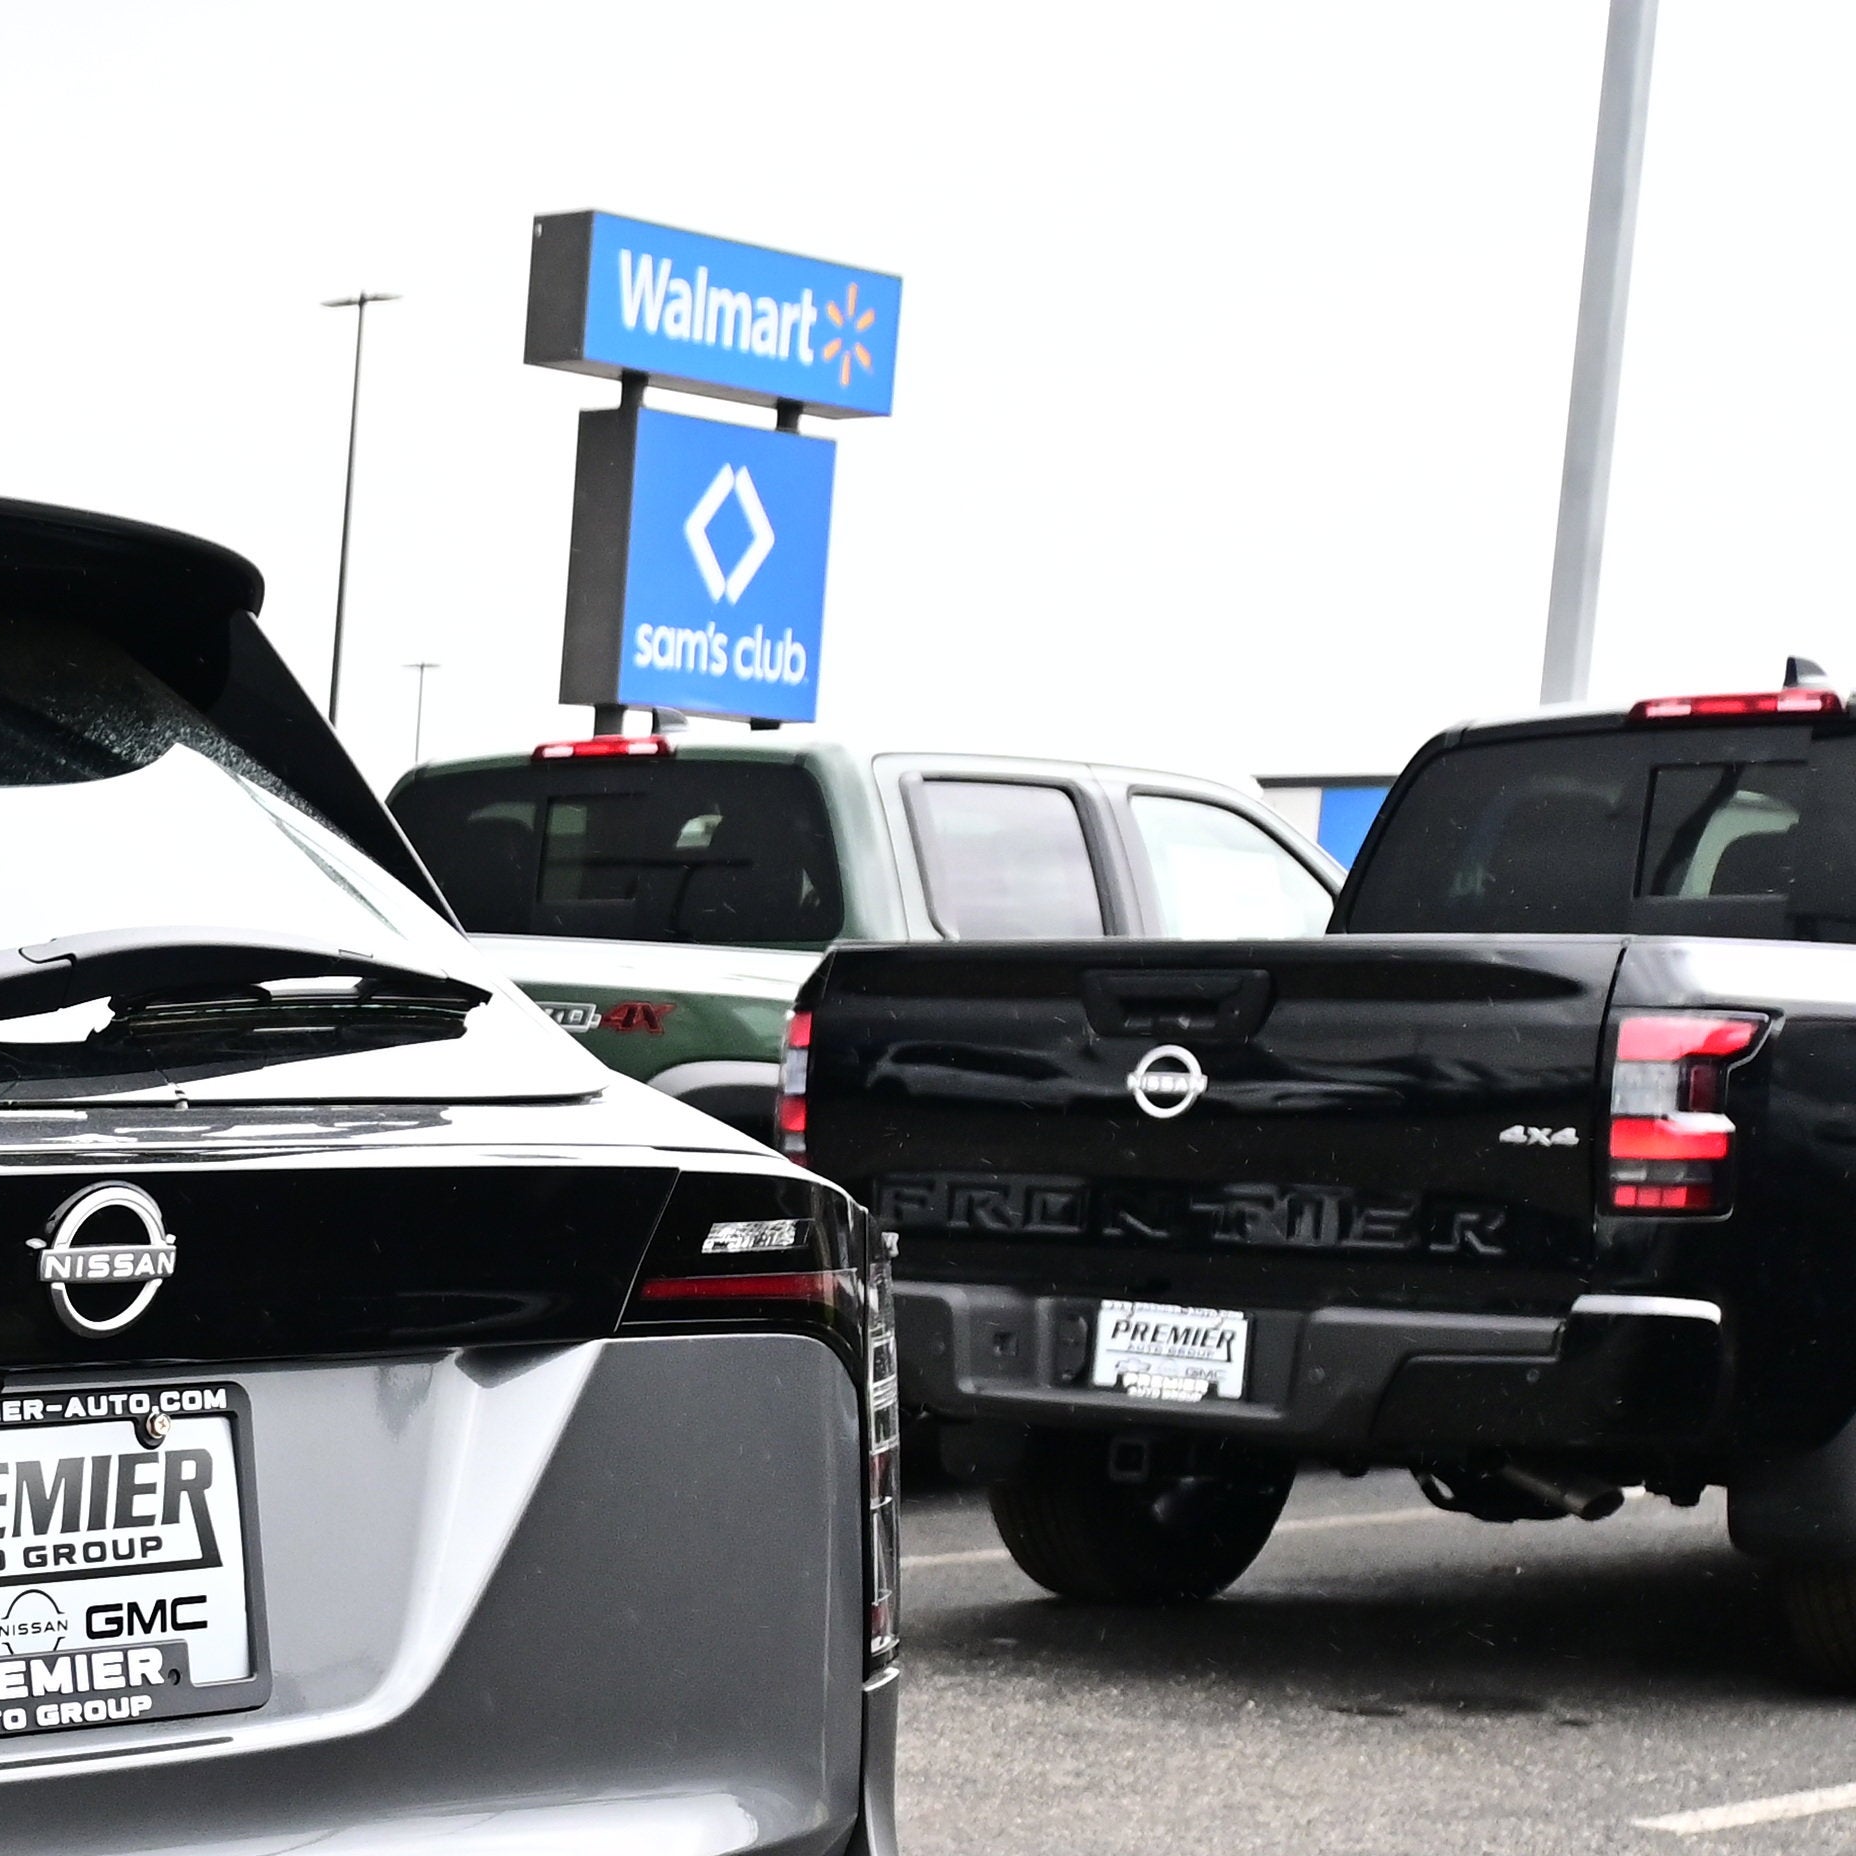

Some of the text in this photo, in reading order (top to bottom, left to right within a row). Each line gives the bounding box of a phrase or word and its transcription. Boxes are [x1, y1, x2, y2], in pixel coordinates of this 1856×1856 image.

[618, 247, 818, 366] Walmart
[634, 621, 808, 684] sam's club
[1126, 1073, 1208, 1093] NISSAN
[44, 1251, 175, 1279] NISSAN
[1111, 1320, 1237, 1353] PREMIER
[1185, 1367, 1227, 1381] GMC
[23, 1536, 164, 1568] GROUP
[85, 1595, 208, 1640] GMC
[36, 1695, 153, 1727] GROUP
